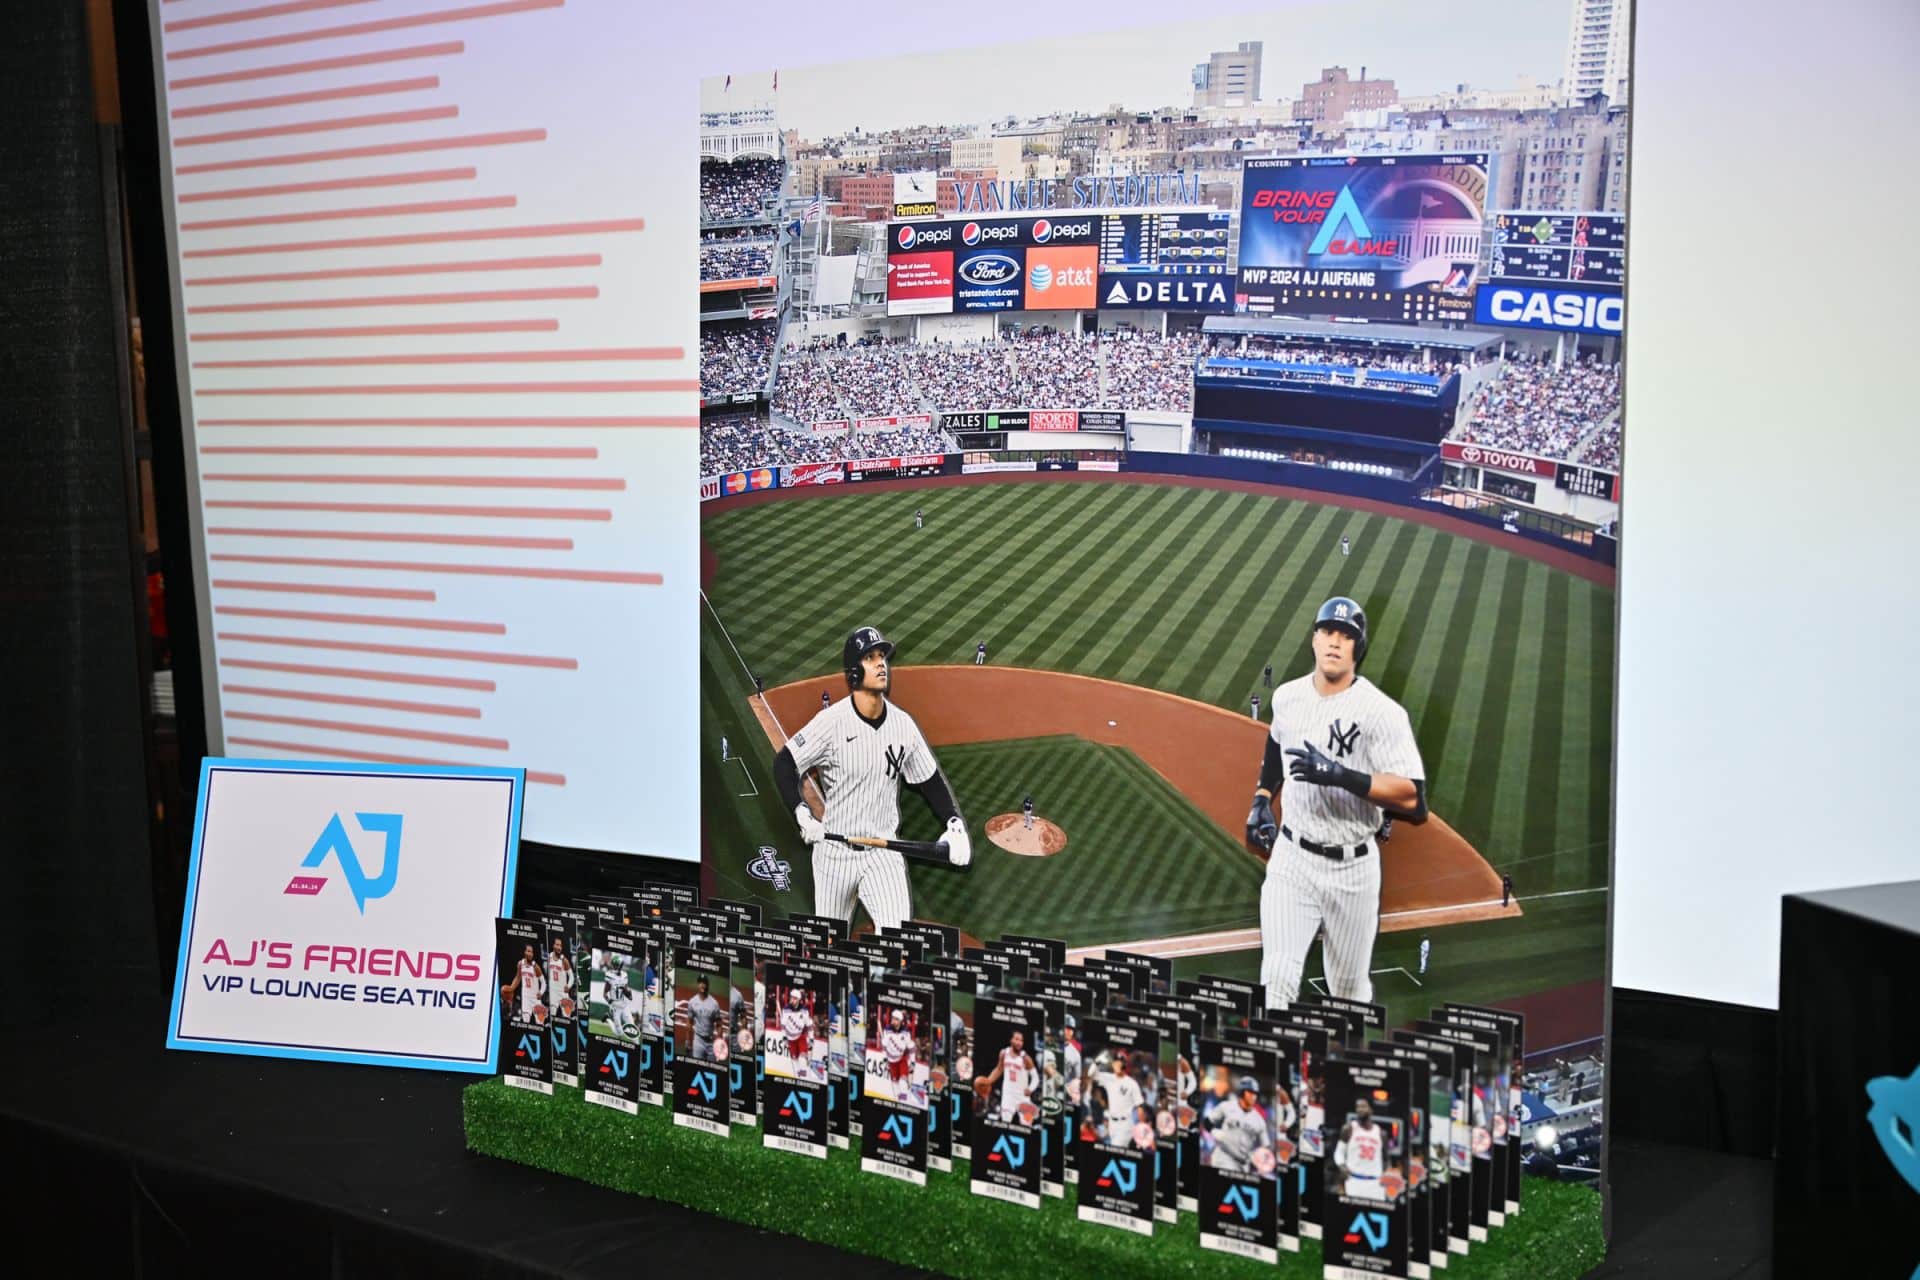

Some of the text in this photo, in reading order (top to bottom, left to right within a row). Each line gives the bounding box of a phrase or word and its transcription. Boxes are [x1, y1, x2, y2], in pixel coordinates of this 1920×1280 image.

[952, 173, 1200, 213] YANKEE STADIUM
[1252, 190, 1336, 208] BRING
[896, 204, 936, 216] Armitron
[1273, 210, 1325, 224] YOUR
[916, 227, 952, 244] pepsi
[982, 224, 1019, 242] pepsi
[1052, 221, 1091, 239] pepsi
[1328, 240, 1398, 256] GAME
[972, 260, 1006, 280] Ford
[1056, 267, 1094, 286] at&t
[1243, 269, 1376, 287] MVP 2024 AJ AUFGANG
[1136, 281, 1227, 303] DELTA
[1490, 289, 1624, 331] CASIO
[945, 415, 981, 429] ZALES
[1032, 412, 1075, 424] SPORTS
[1482, 451, 1537, 473] TOYOTA
[1327, 718, 1361, 758] NY
[885, 744, 906, 780] NY
[202, 938, 481, 982] AJ'S FRIENDS
[202, 974, 477, 1011] VIP LOUNGE SEATING
